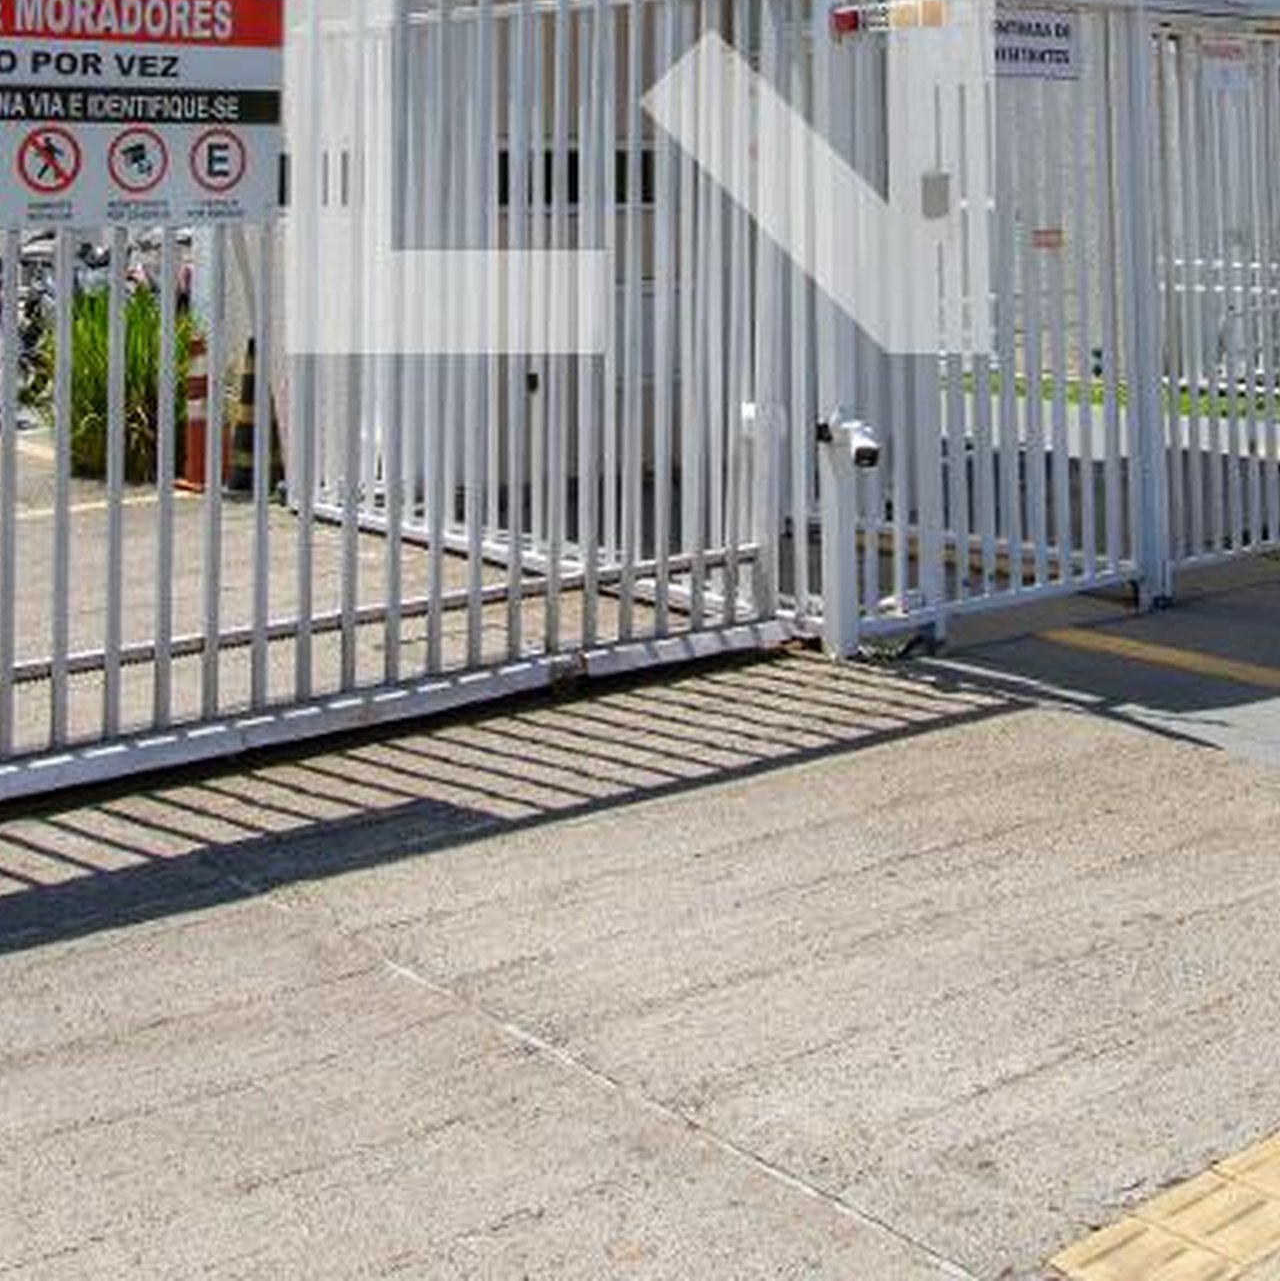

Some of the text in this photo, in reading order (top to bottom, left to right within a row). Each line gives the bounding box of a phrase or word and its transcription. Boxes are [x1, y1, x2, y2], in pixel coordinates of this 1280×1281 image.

[31, 50, 103, 76] POR
[115, 54, 180, 79] VEZ
[29, 92, 66, 117] VIA
[69, 93, 83, 118] E
[86, 94, 240, 120] IDENTIFIQUE-SE
[206, 143, 230, 177] E
